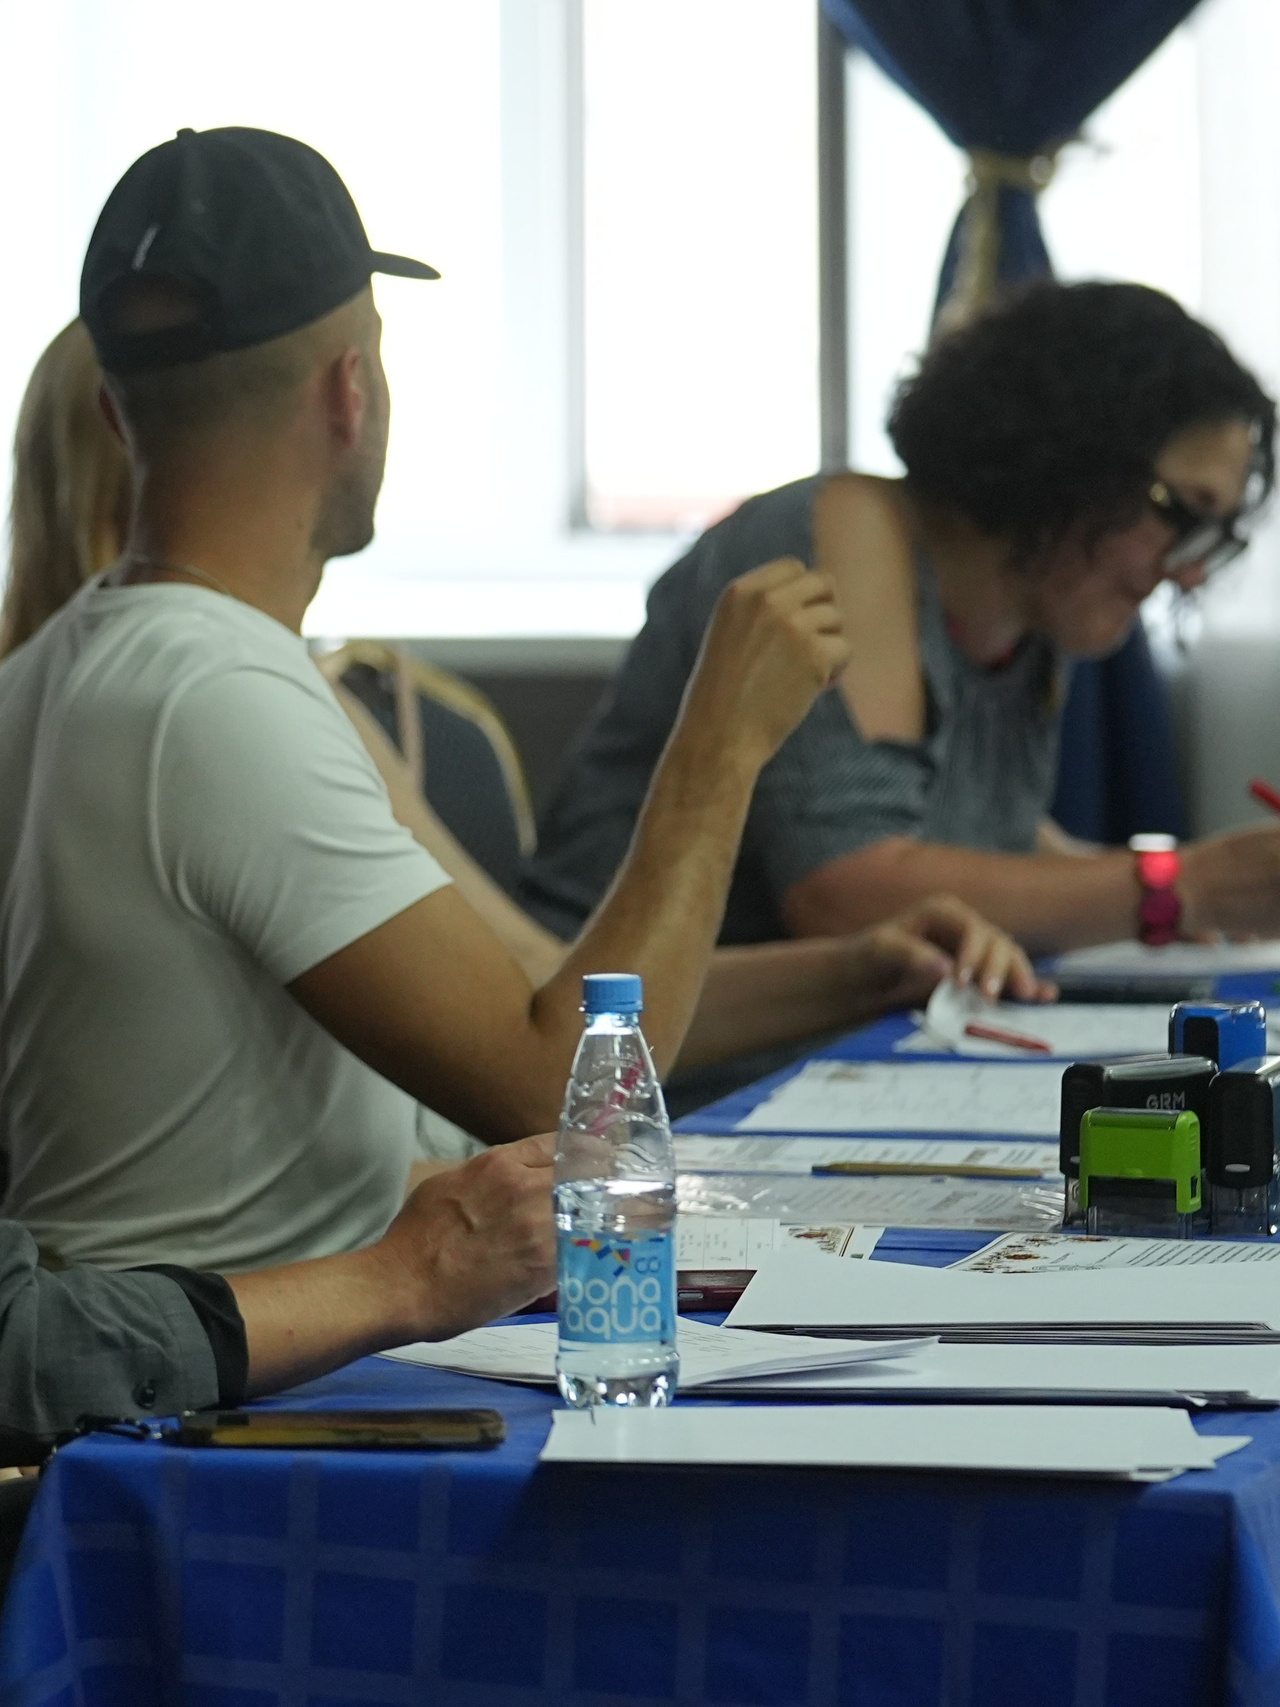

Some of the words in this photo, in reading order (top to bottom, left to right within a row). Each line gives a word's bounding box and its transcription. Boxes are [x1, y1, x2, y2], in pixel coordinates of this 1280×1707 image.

[1146, 1091, 1186, 1110] GRM
[564, 1274, 661, 1304] bona
[566, 1305, 661, 1340] aqua
